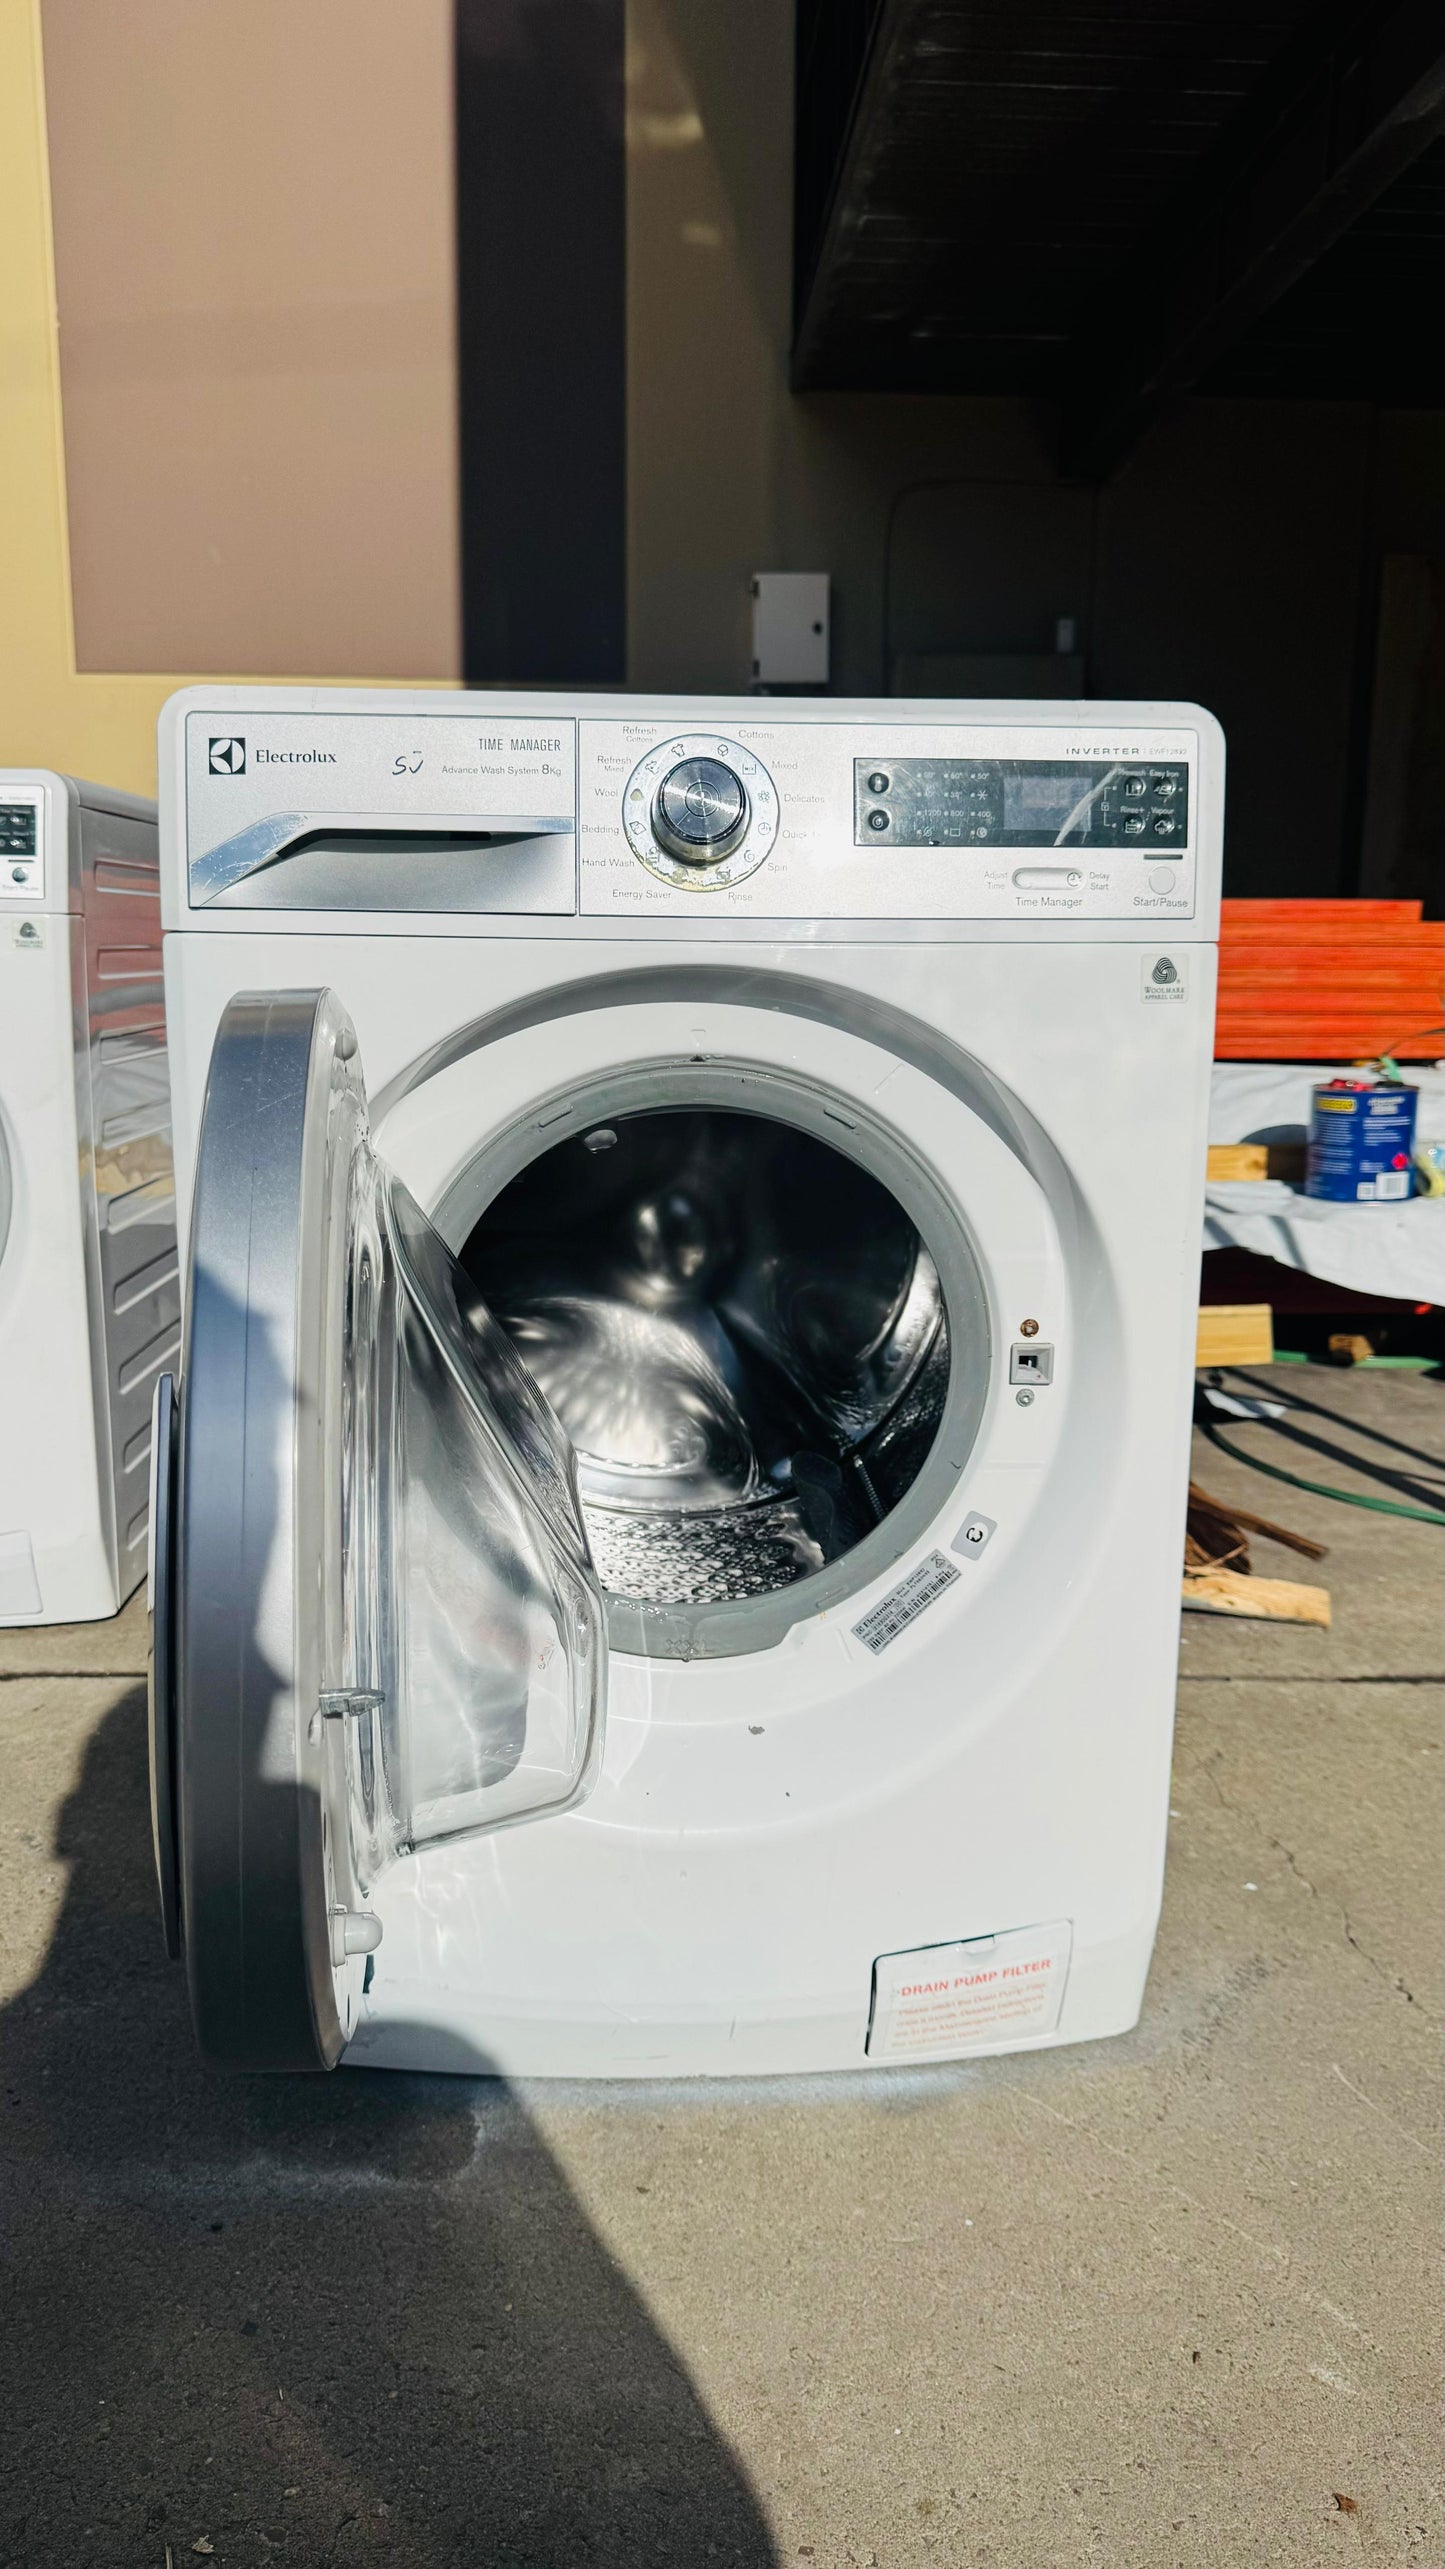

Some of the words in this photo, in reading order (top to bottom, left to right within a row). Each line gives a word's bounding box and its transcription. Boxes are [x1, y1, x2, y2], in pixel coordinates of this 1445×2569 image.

[623, 726, 657, 736] Refresh
[738, 730, 775, 740] Cottons
[478, 738, 504, 751] TIME
[510, 738, 561, 752] MANAGER
[1066, 747, 1140, 755] INVERTER
[256, 749, 338, 765] Electrolux
[597, 755, 632, 766] Refresh
[771, 761, 799, 770] Mixed
[442, 766, 479, 775] Advance
[481, 766, 506, 775] Wash
[507, 766, 539, 777] System
[594, 788, 619, 798] Wool
[784, 793, 826, 803] Delicates
[582, 824, 620, 835] Bedding
[582, 858, 606, 868] Hand
[609, 858, 636, 868] Wash
[767, 862, 788, 874] Spin
[984, 870, 1008, 881] Adjust
[1089, 872, 1110, 882] Delay
[1090, 882, 1109, 891] Start
[612, 889, 644, 901] Energy
[646, 890, 672, 900] Saver
[1016, 897, 1038, 906] Time
[1040, 897, 1082, 909] Manager
[1133, 897, 1189, 908] Start/Pause
[862, 1597, 898, 1629] Electrolux
[900, 1980, 949, 1997] DRAIN
[953, 1971, 998, 1989] PUMP
[1001, 1958, 1052, 1979] FILTER
